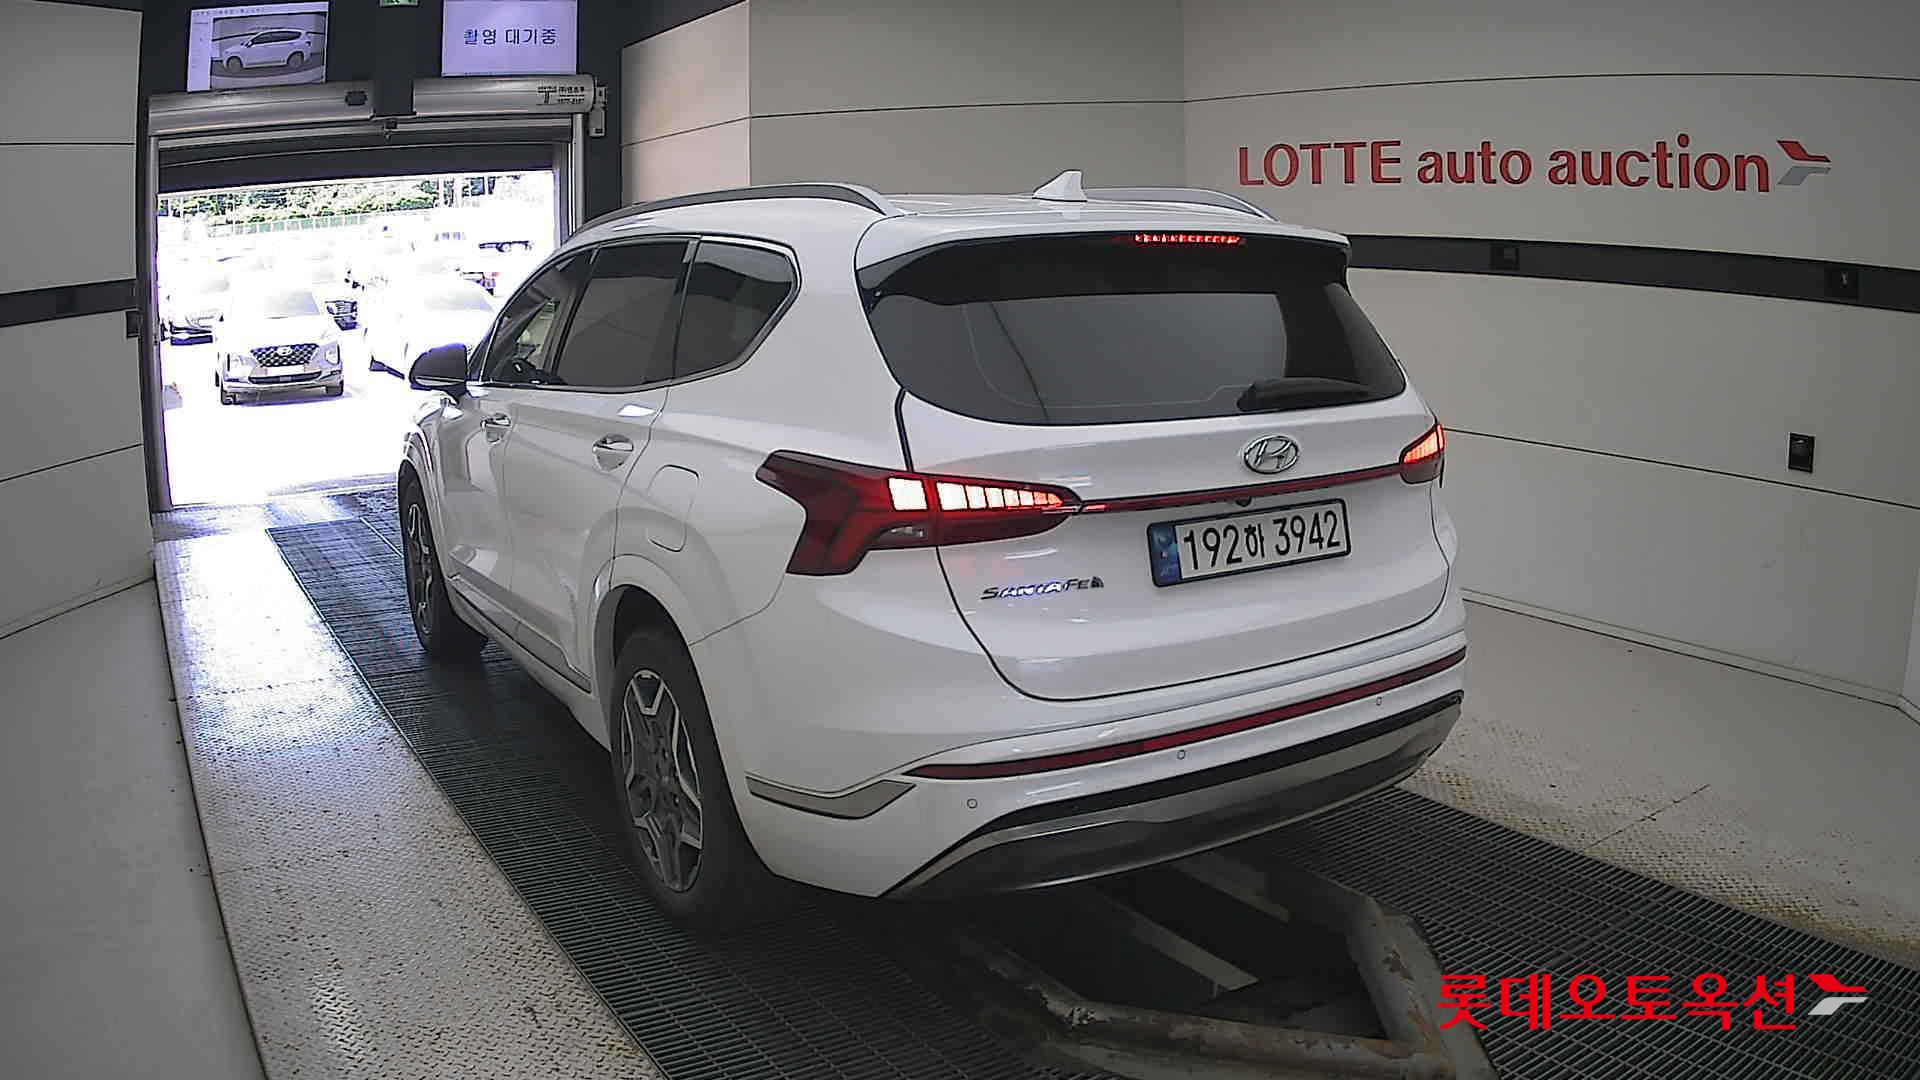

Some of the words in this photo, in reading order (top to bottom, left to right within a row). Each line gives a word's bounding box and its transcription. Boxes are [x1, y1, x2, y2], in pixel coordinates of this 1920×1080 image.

[463, 28, 497, 46] 촬영
[504, 29, 558, 46] 대기중
[1239, 140, 1402, 186] LOTTE
[1417, 140, 1532, 185] auto
[1547, 133, 1769, 192] auction
[1184, 523, 1265, 571] 192하
[1273, 510, 1341, 557] 3942
